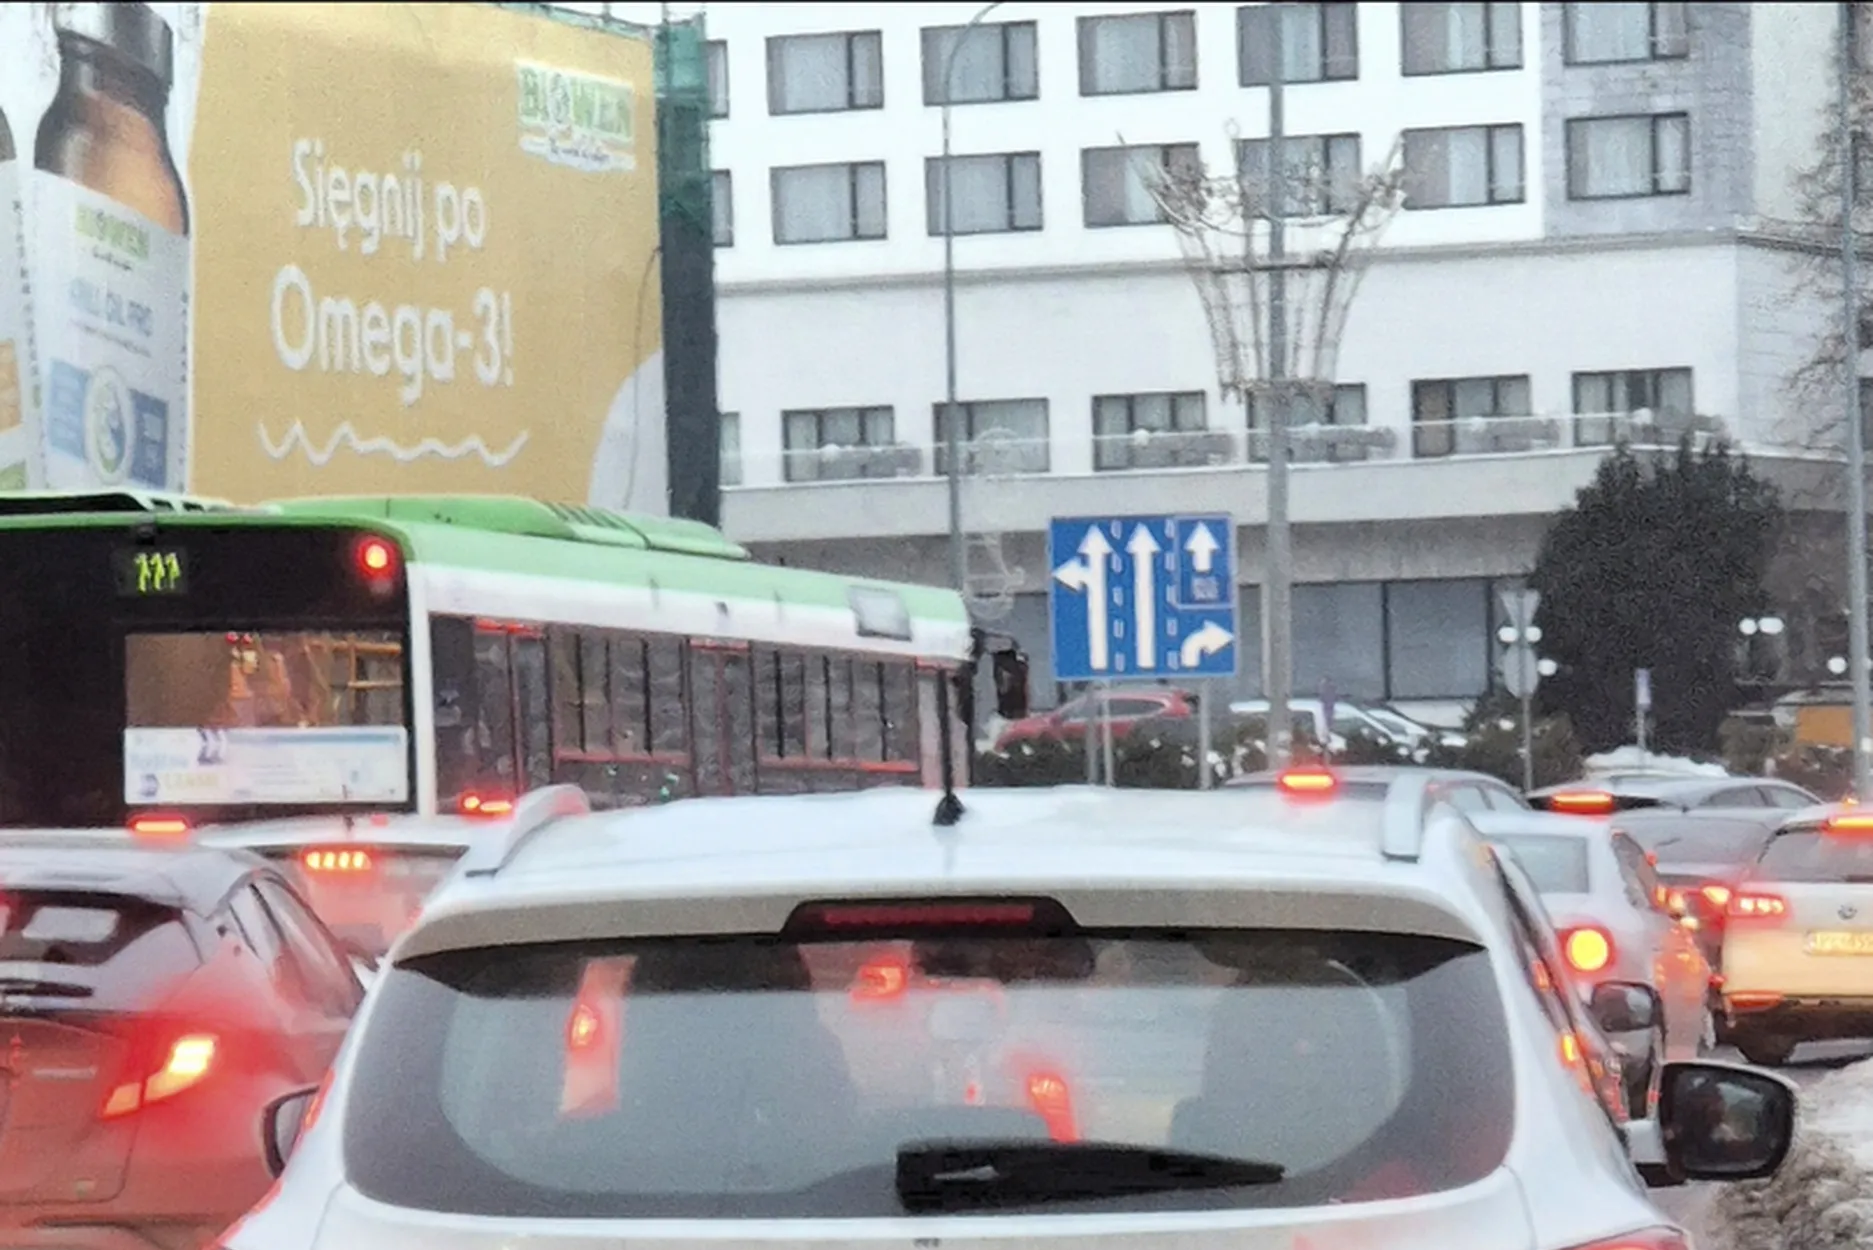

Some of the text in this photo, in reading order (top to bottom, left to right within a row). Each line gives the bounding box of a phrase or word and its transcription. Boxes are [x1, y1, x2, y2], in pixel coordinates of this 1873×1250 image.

[292, 137, 486, 262] Sięgnij po
[271, 263, 514, 406] Omega-3!
